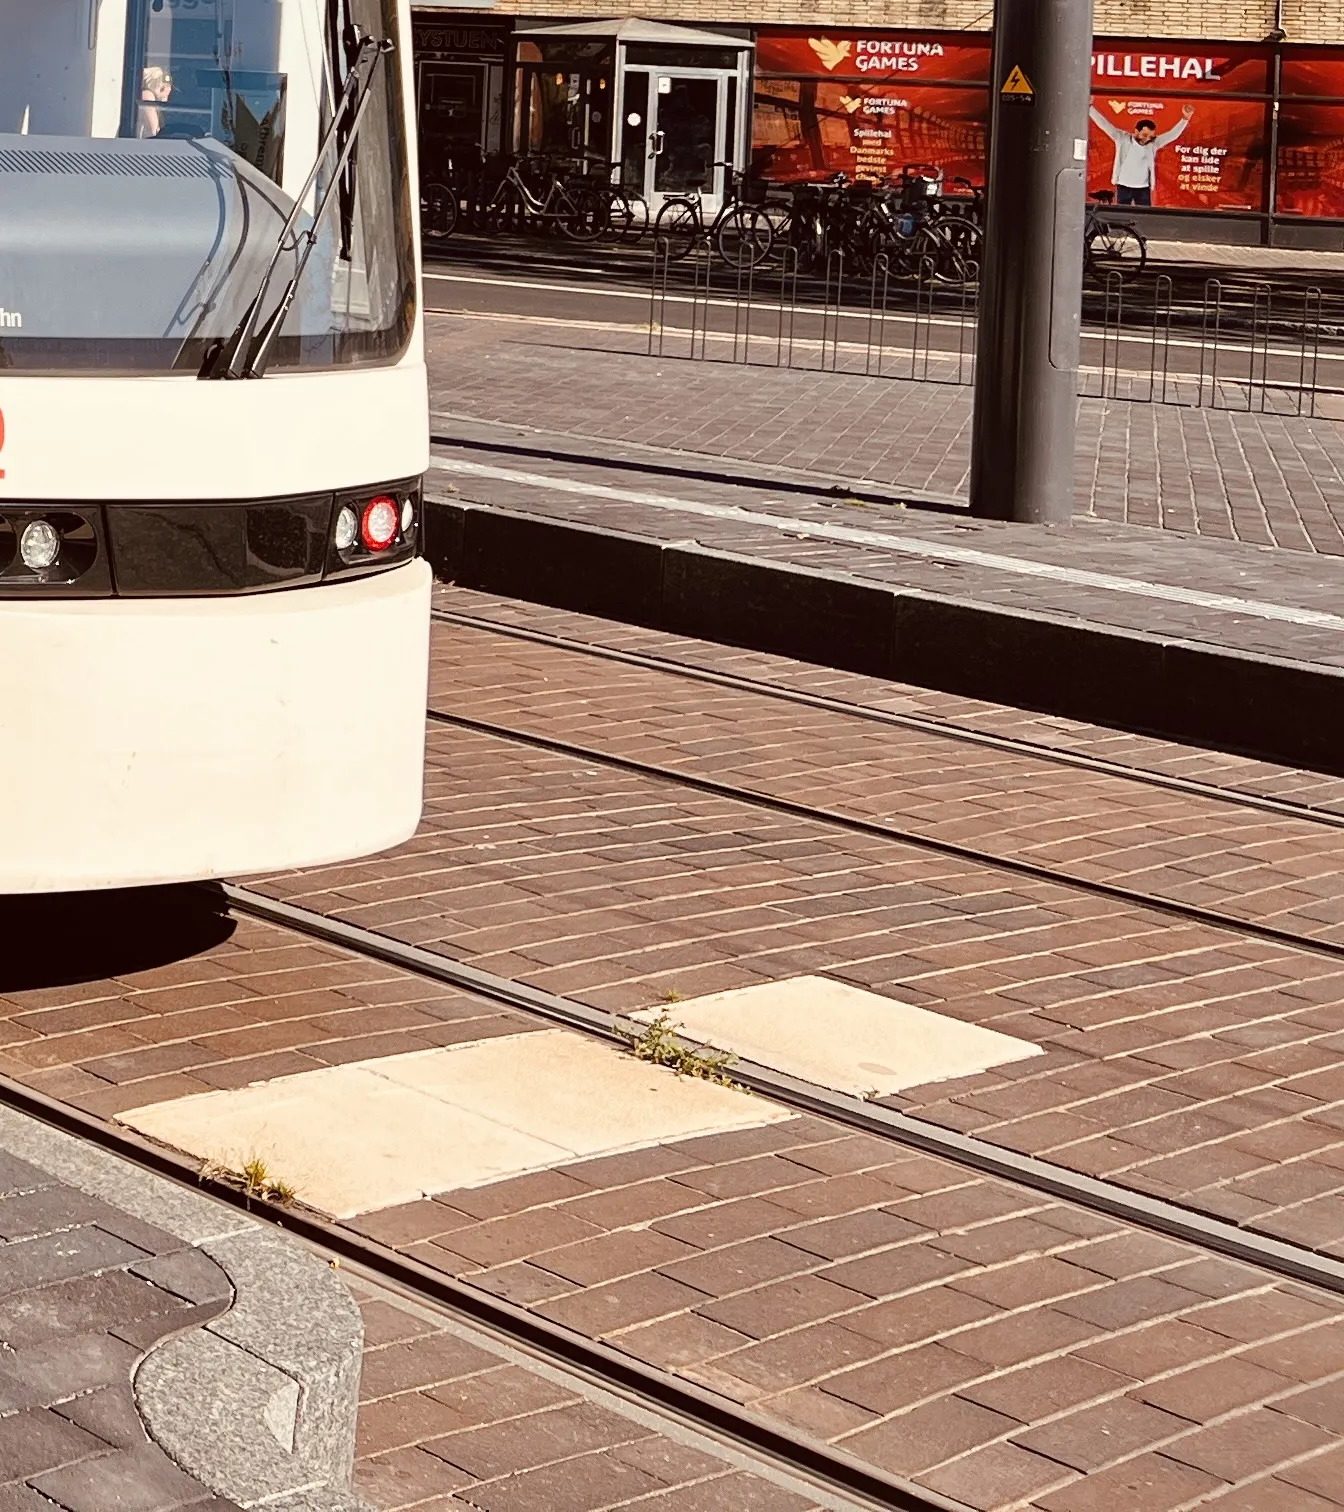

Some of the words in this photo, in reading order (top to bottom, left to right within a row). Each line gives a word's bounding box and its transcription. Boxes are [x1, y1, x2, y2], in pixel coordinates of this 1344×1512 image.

[856, 40, 943, 57] FORTUNA
[855, 56, 919, 72] GAMES
[863, 97, 909, 108] FORTUNA
[1127, 101, 1164, 110] FORTUNA
[863, 106, 896, 115] GAMES
[1127, 108, 1154, 116] GAMES
[853, 128, 892, 138] Spillehal
[850, 146, 895, 156] Danmarks
[1175, 145, 1190, 153] For
[1192, 145, 1209, 156] dig
[1210, 146, 1228, 156] der
[856, 155, 887, 164] bedste
[1181, 154, 1199, 163] kan
[1201, 155, 1220, 164] lide
[1181, 164, 1191, 172] at
[1192, 165, 1220, 174] spille
[1177, 174, 1190, 183] og
[1192, 174, 1222, 183] elsker
[1192, 183, 1219, 192] vinde
